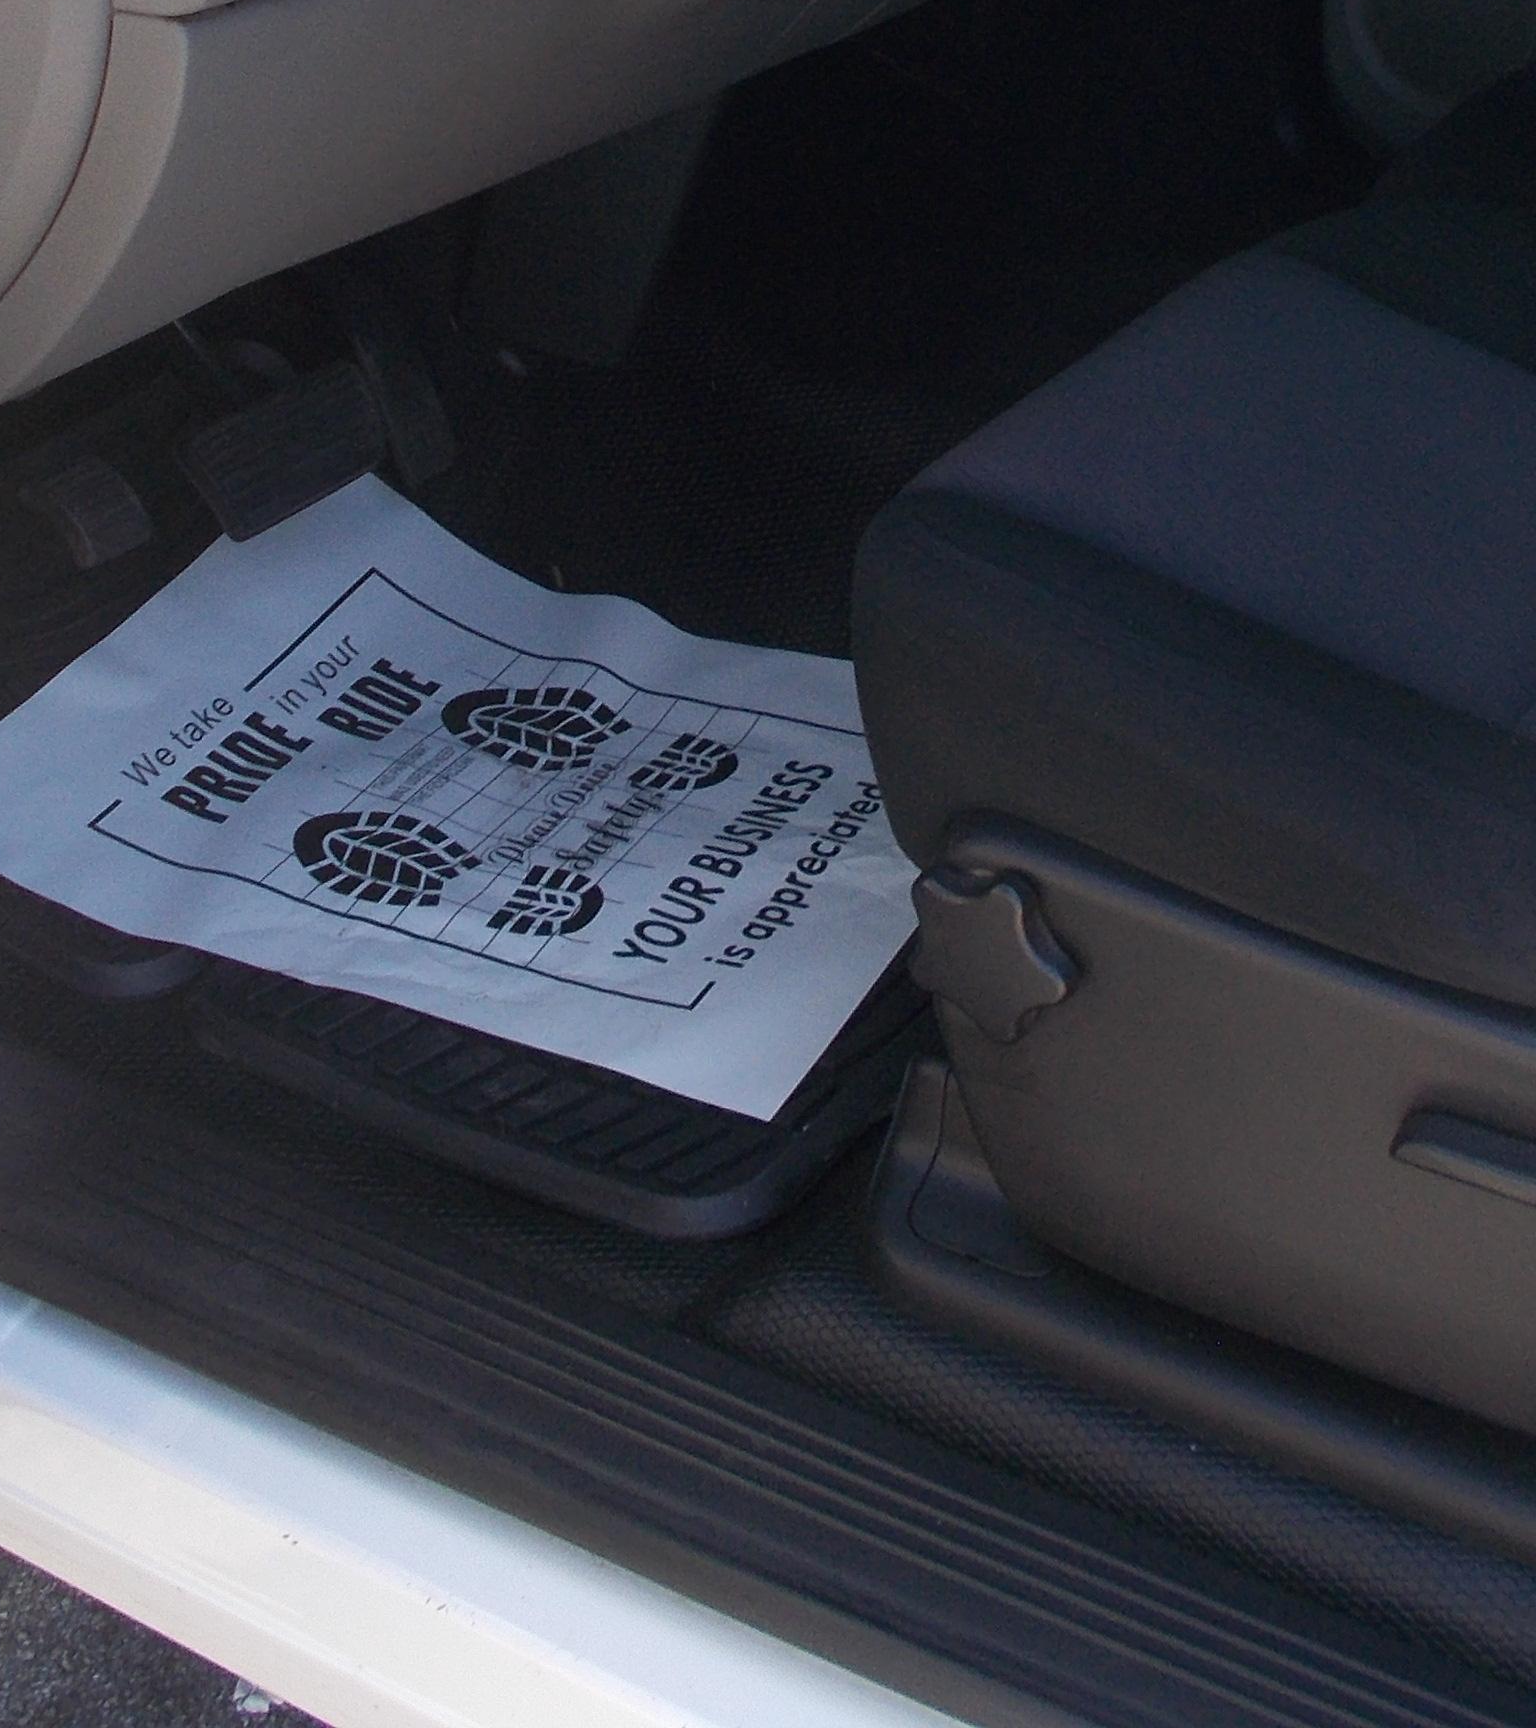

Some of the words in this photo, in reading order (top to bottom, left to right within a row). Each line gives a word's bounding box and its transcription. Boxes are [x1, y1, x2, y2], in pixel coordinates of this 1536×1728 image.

[120, 746, 177, 787] We
[169, 695, 235, 750] take
[160, 710, 315, 825] PRIDE
[268, 687, 309, 716] in
[300, 634, 360, 697] your
[316, 657, 443, 742] RIDE
[487, 809, 568, 865] Please
[550, 763, 614, 807] Drive
[612, 875, 725, 964] YOUR
[689, 759, 834, 879] BUSINESS
[704, 944, 756, 969] is
[742, 780, 882, 941] appreciated
